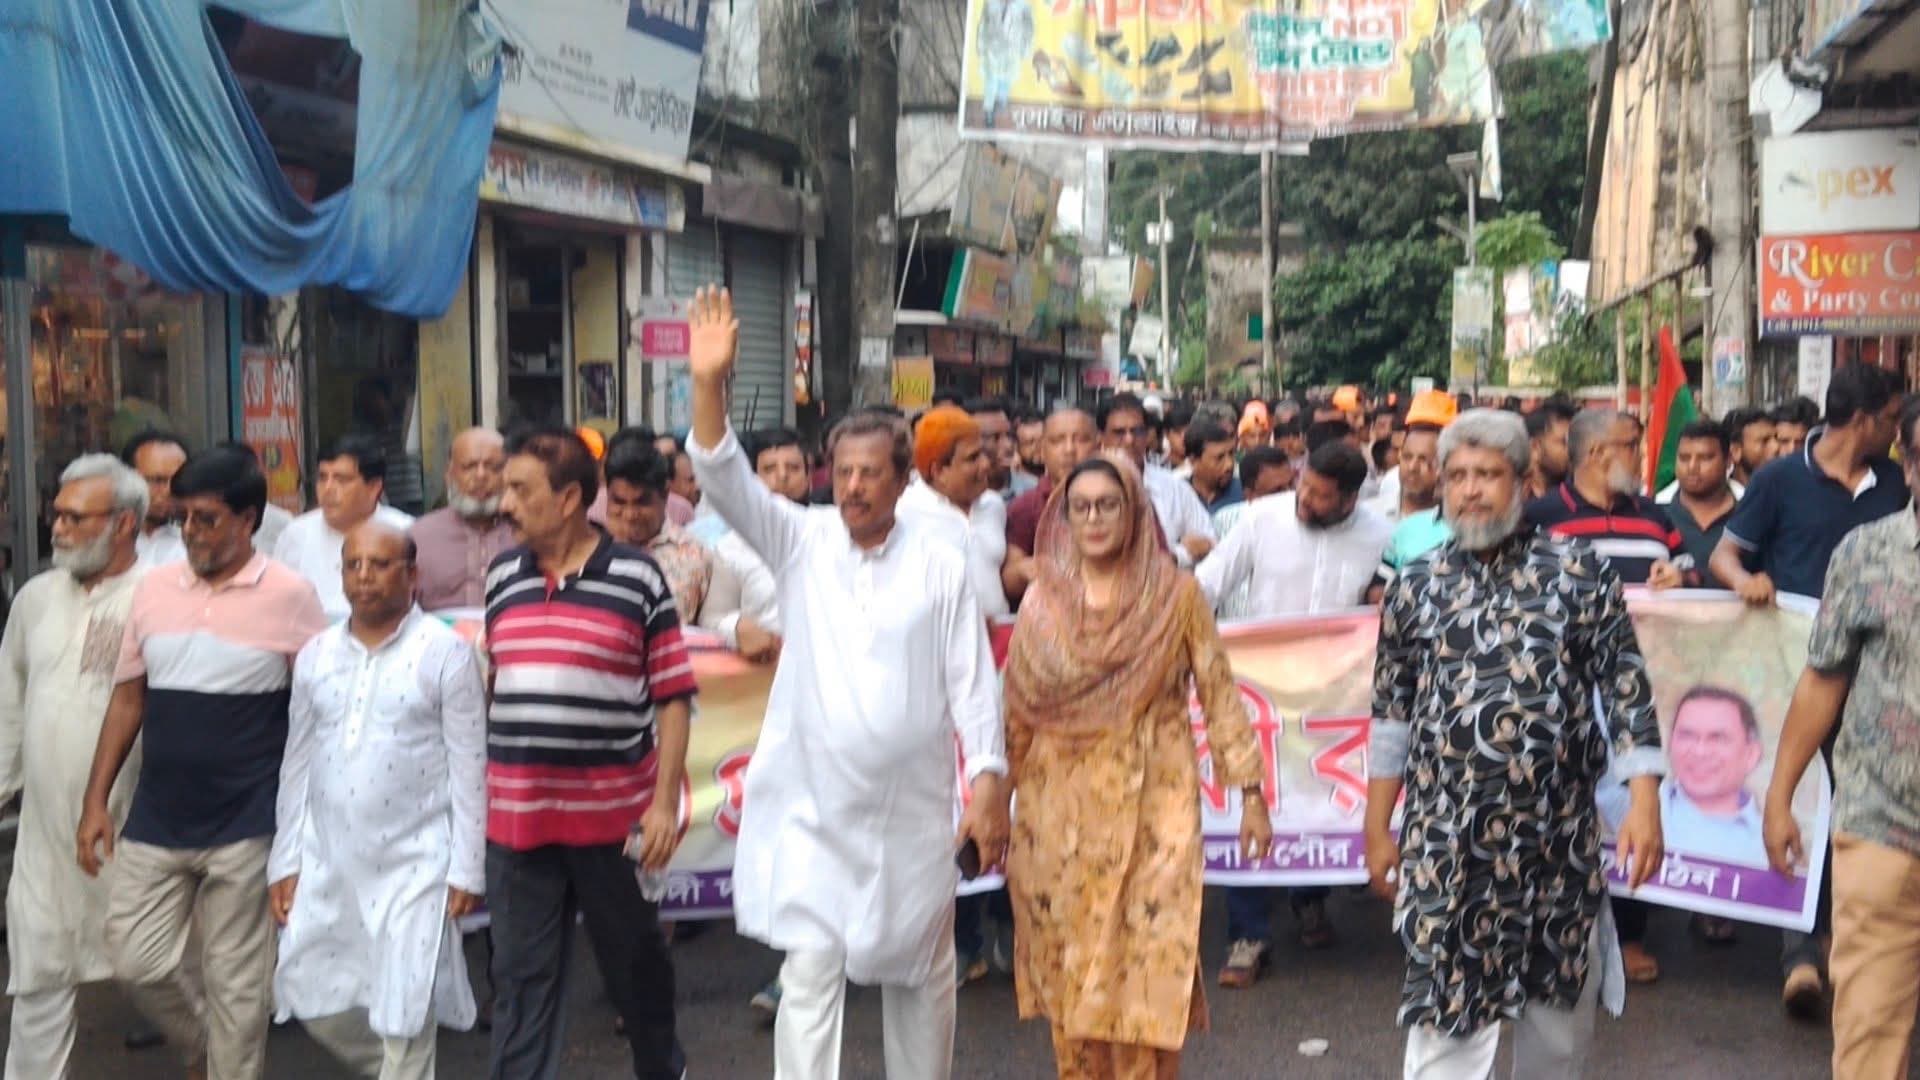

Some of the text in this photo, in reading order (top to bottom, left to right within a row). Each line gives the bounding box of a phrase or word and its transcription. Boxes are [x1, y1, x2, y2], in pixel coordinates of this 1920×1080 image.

[1769, 236, 1920, 289] River C
[1771, 289, 1792, 312] &
[1802, 287, 1873, 316] Party
